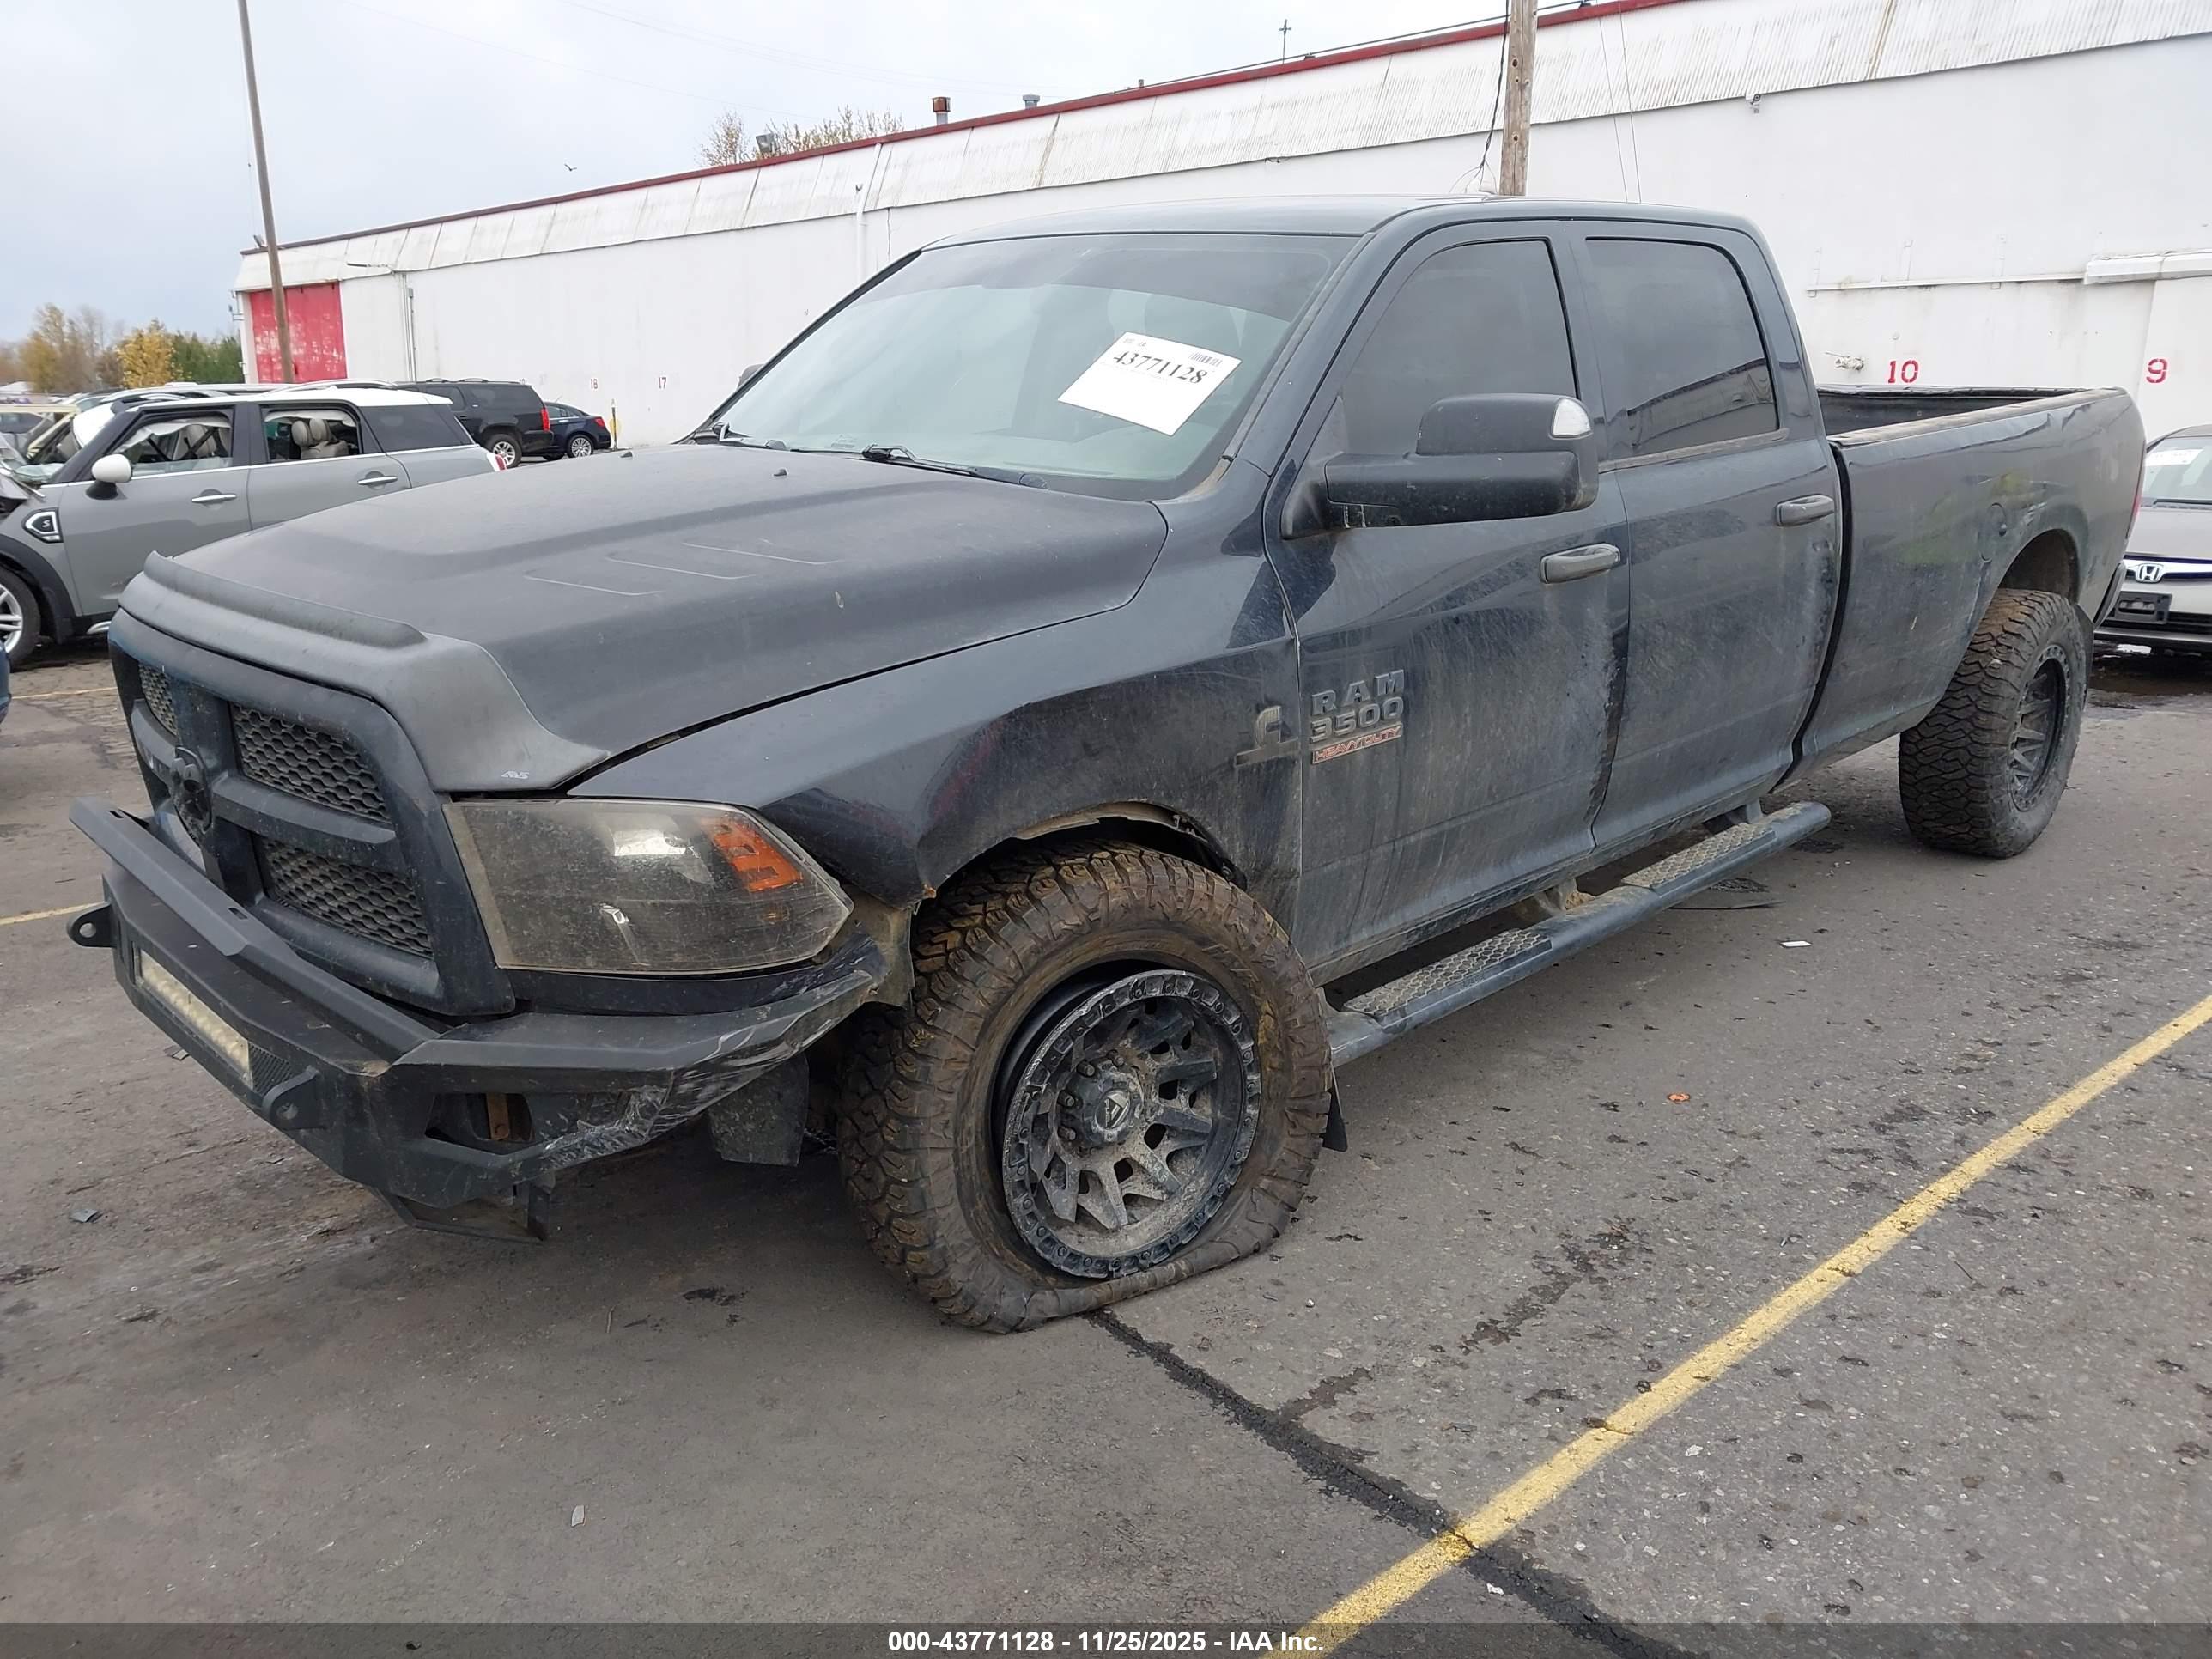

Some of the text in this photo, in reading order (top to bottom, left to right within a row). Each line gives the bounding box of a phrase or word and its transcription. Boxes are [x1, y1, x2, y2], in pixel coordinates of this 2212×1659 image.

[1114, 350, 1207, 384] 43771128
[1888, 360, 1919, 383] 10
[2147, 358, 2168, 384] 9
[591, 378, 599, 390] 18
[659, 376, 667, 389] 17
[1311, 669, 1404, 715] RAM
[1310, 696, 1404, 743] 3500
[1315, 726, 1401, 762] HEAVY DUTY
